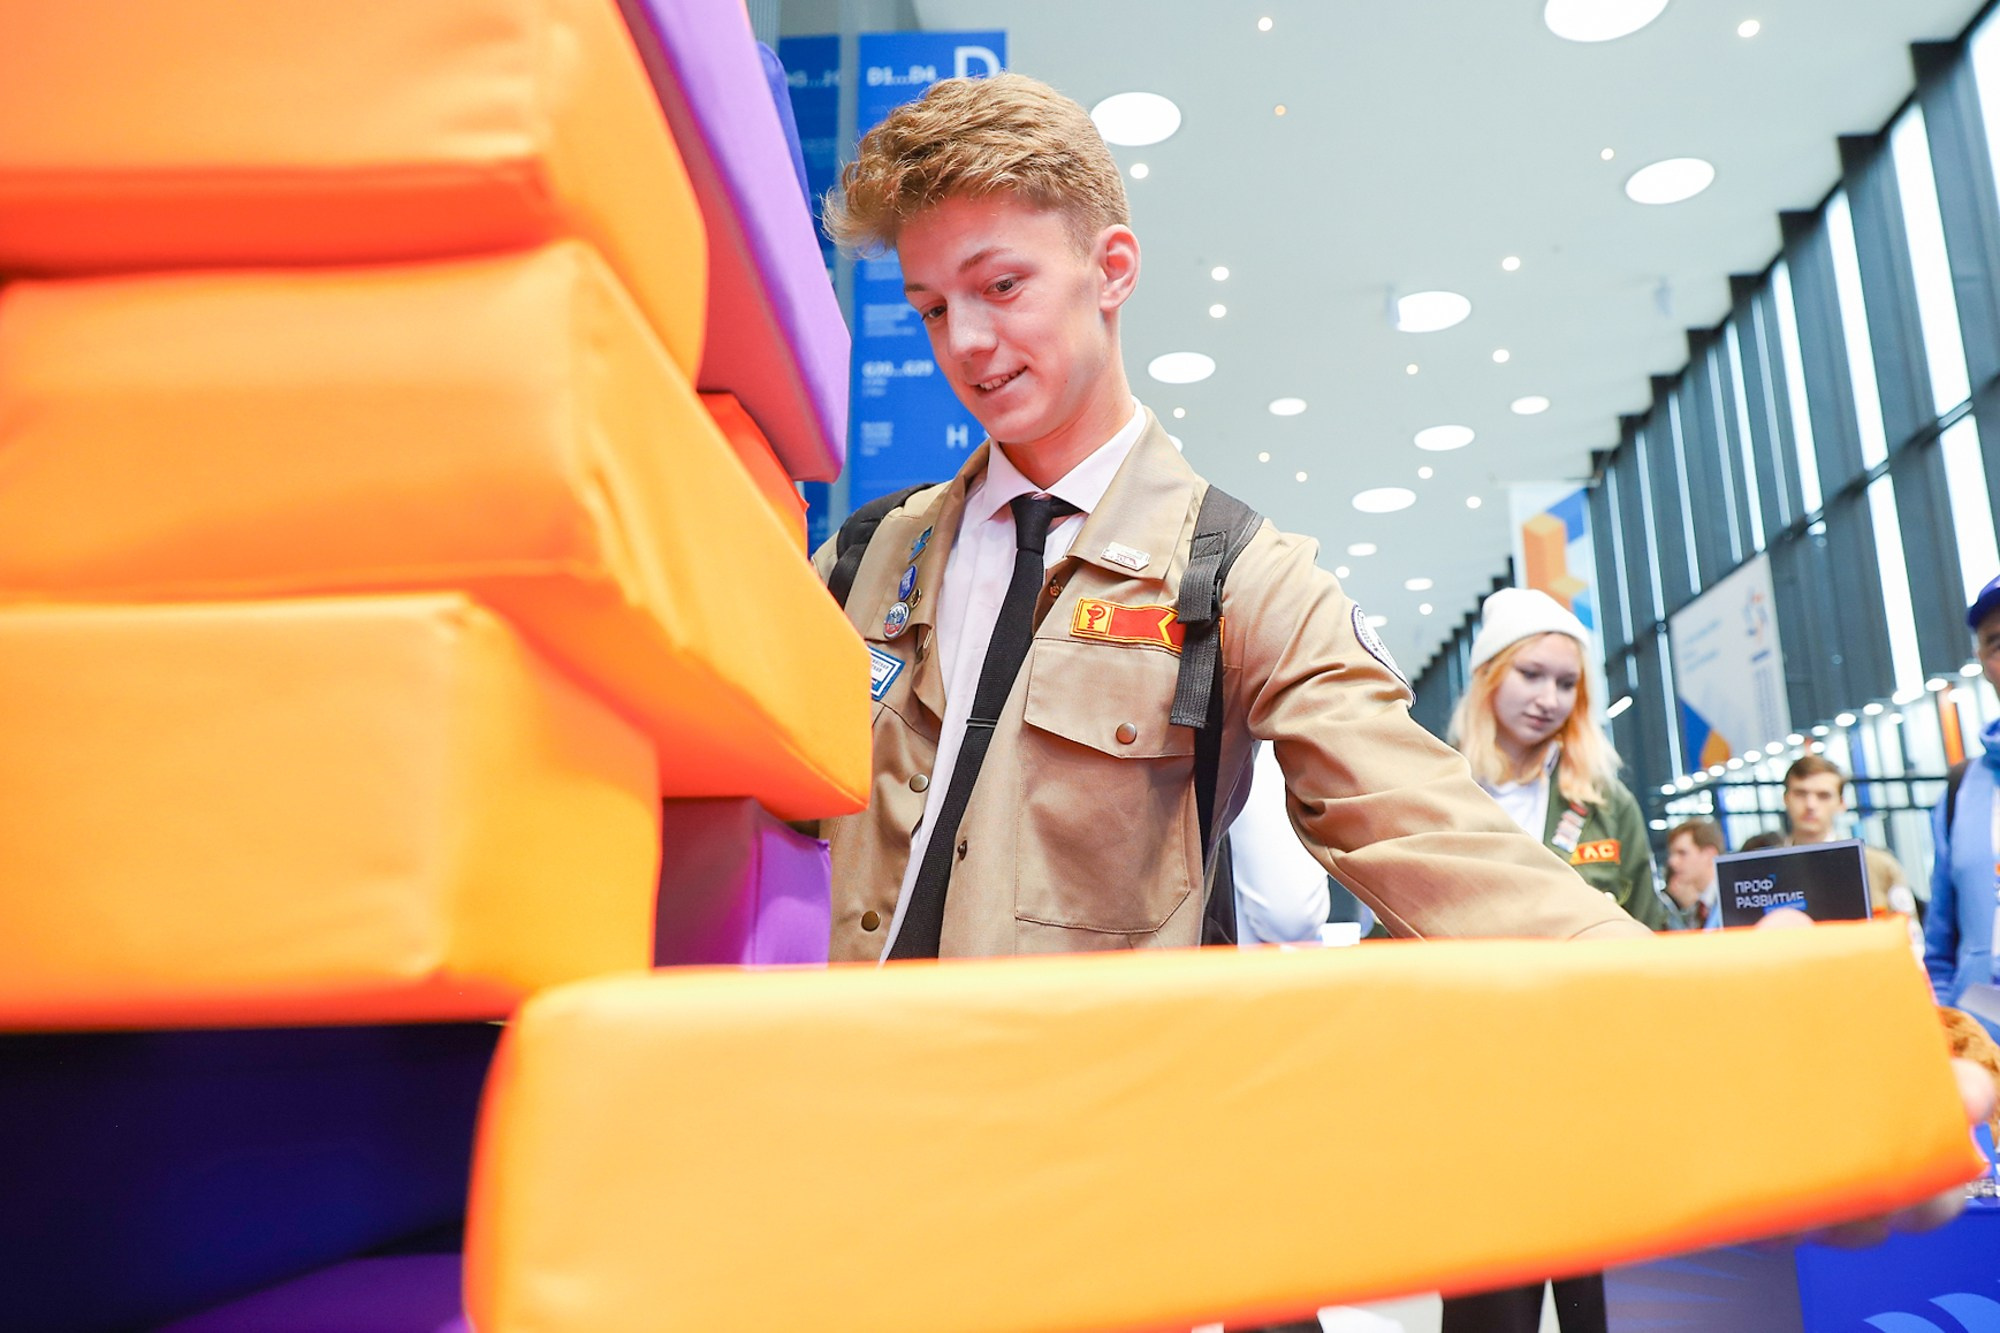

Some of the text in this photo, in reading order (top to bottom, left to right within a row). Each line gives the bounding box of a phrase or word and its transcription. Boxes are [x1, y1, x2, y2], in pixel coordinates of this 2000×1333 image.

[954, 45, 1001, 79] D
[1734, 878, 1774, 894] ПРОФ
[1736, 891, 1805, 909] РАЗВИТИЕ
